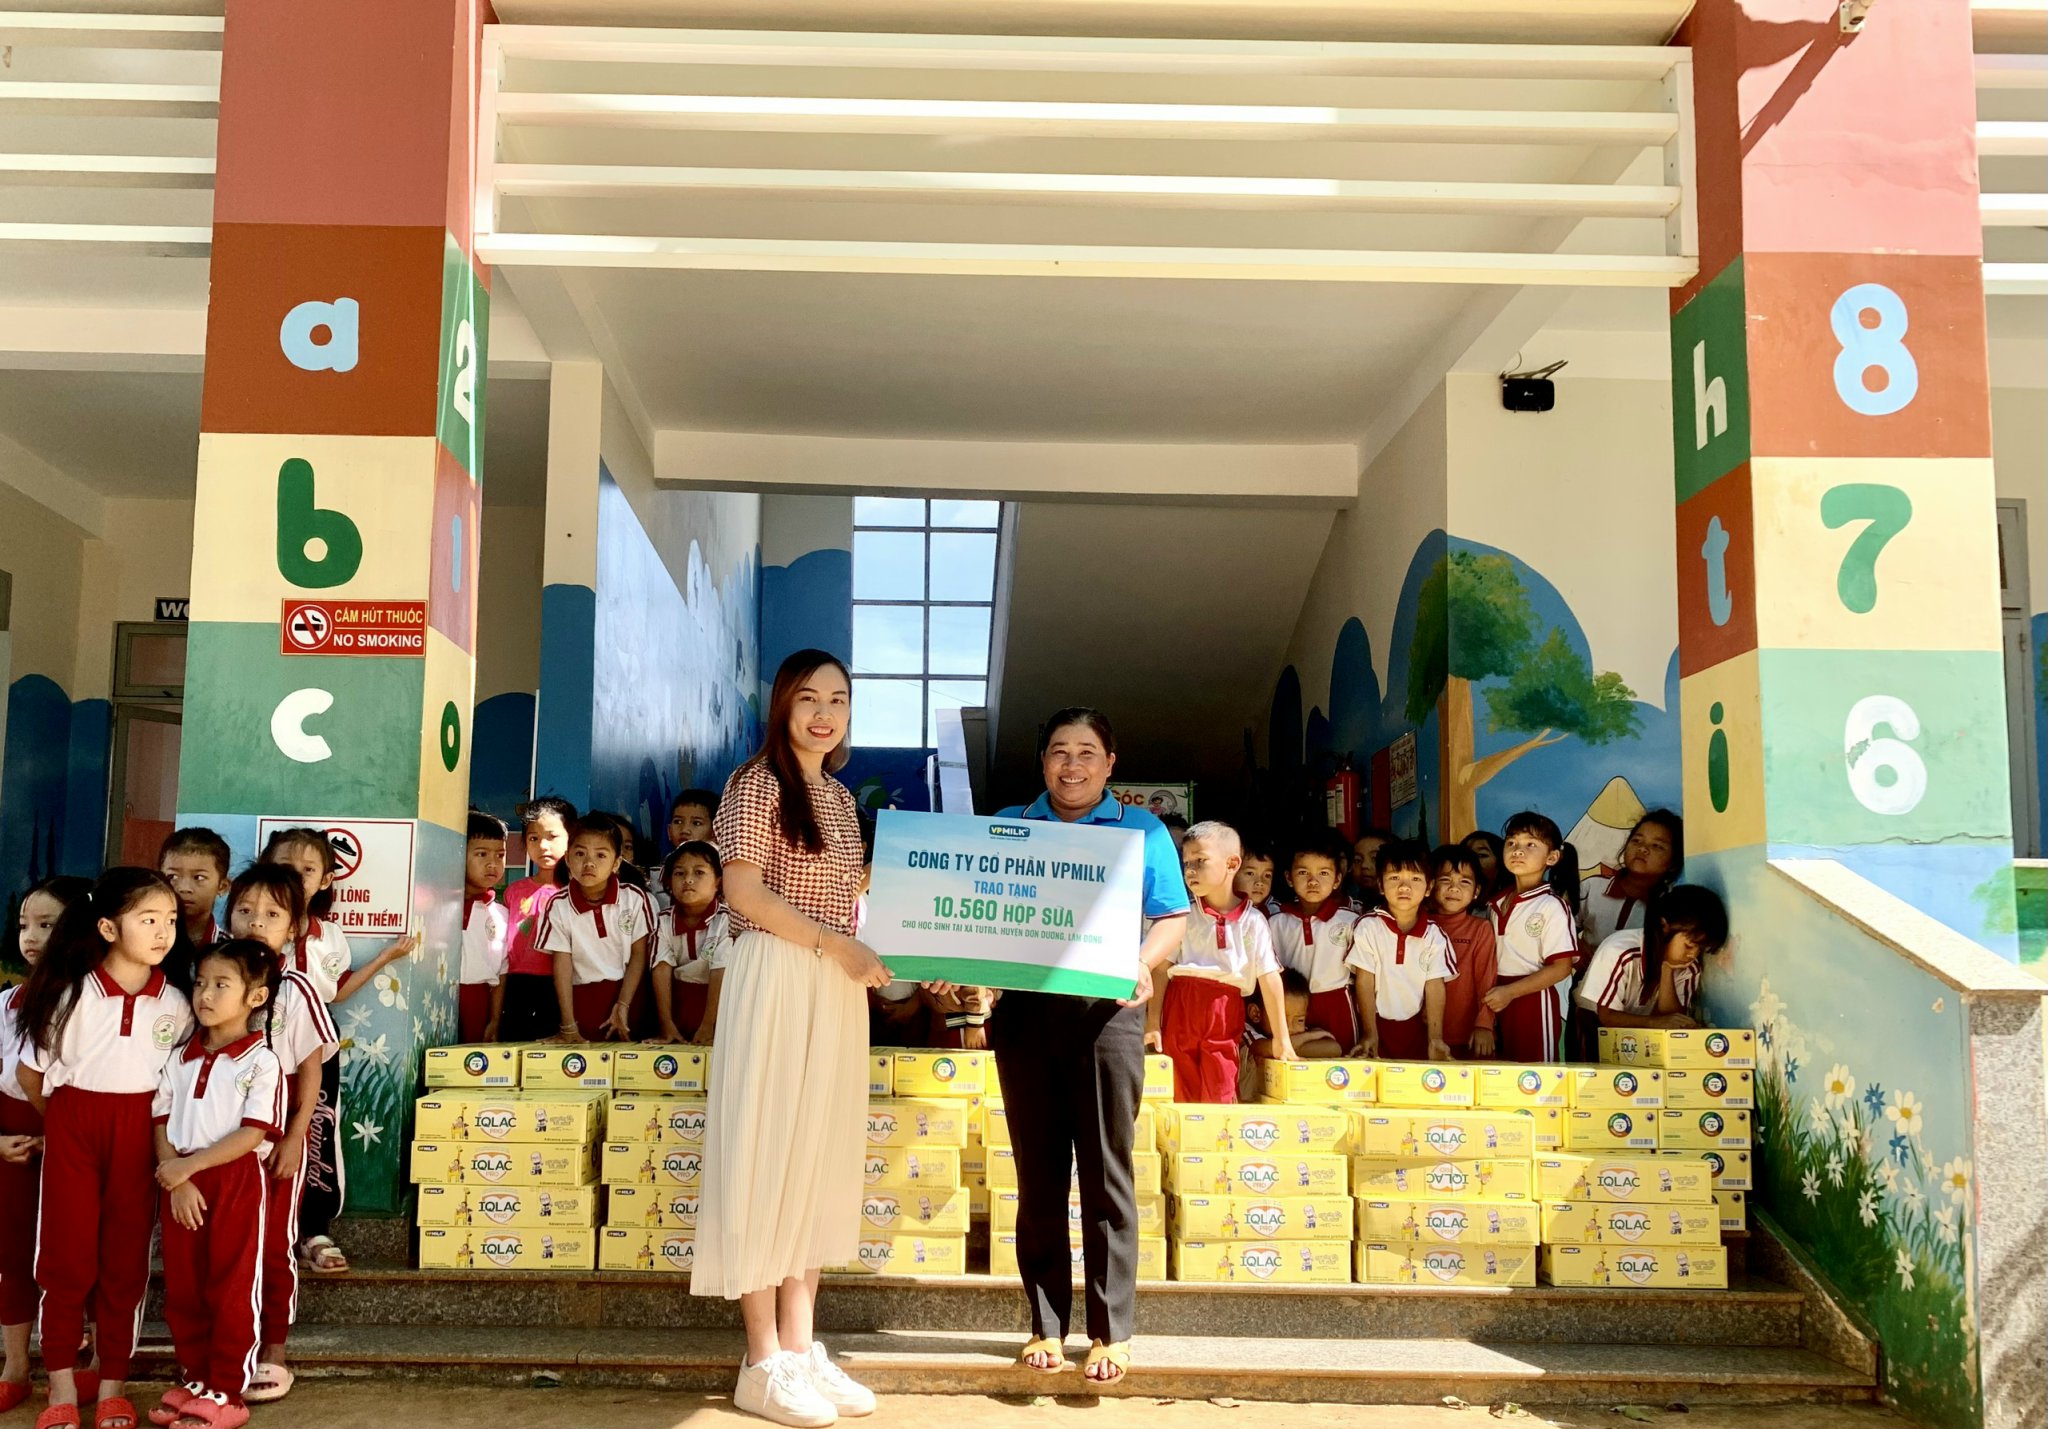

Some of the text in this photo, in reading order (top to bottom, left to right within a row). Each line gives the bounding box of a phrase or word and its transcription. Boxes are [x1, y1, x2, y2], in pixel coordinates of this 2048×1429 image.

[280, 297, 359, 372] a
[1830, 283, 1918, 416] 8
[1693, 340, 1728, 450] h
[277, 457, 363, 588] b
[1820, 483, 1912, 614] 7
[1701, 515, 1733, 626] t
[361, 606, 384, 623] HÚT
[386, 607, 423, 624] THUỐC
[333, 634, 422, 648] NO SMOKING
[271, 688, 334, 763] c
[1708, 701, 1730, 814] i
[1843, 695, 1928, 815] 6
[991, 827, 1026, 837] VPMILK
[908, 849, 1106, 883] CÔNG TY CỔ PHẦN VPMILK
[341, 886, 370, 902] LÒNG
[974, 880, 1037, 898] TRAO TẶNG
[933, 895, 1074, 927] 10.560 HỘP SỮA
[343, 909, 364, 926] LÊN
[901, 920, 916, 929] CHO
[918, 921, 932, 931] HỌC
[934, 922, 950, 931] SINH
[475, 1116, 517, 1128] IQLAC
[867, 1121, 898, 1131] LAC
[1239, 1129, 1280, 1139] IQLAC
[1424, 1133, 1466, 1144] IQLAC
[471, 1159, 512, 1171] IQLAC
[865, 1163, 889, 1173] LAC
[1238, 1171, 1279, 1182] IQLAC
[1426, 1173, 1469, 1185] IQLAC
[1597, 1176, 1640, 1187] IQLAC
[479, 1201, 521, 1212] IQLAC
[669, 1203, 698, 1214] IQL
[1244, 1213, 1286, 1225] IQLAC
[1425, 1217, 1468, 1228] IQLAC
[1608, 1219, 1651, 1230] IQLAC
[480, 1243, 522, 1255] IQLAC
[660, 1246, 694, 1257] IQLA
[859, 1249, 895, 1259] QLAC
[1240, 1256, 1282, 1267] IQLAC
[1422, 1258, 1466, 1269] IQLAC
[1616, 1261, 1658, 1272] IQLAC
